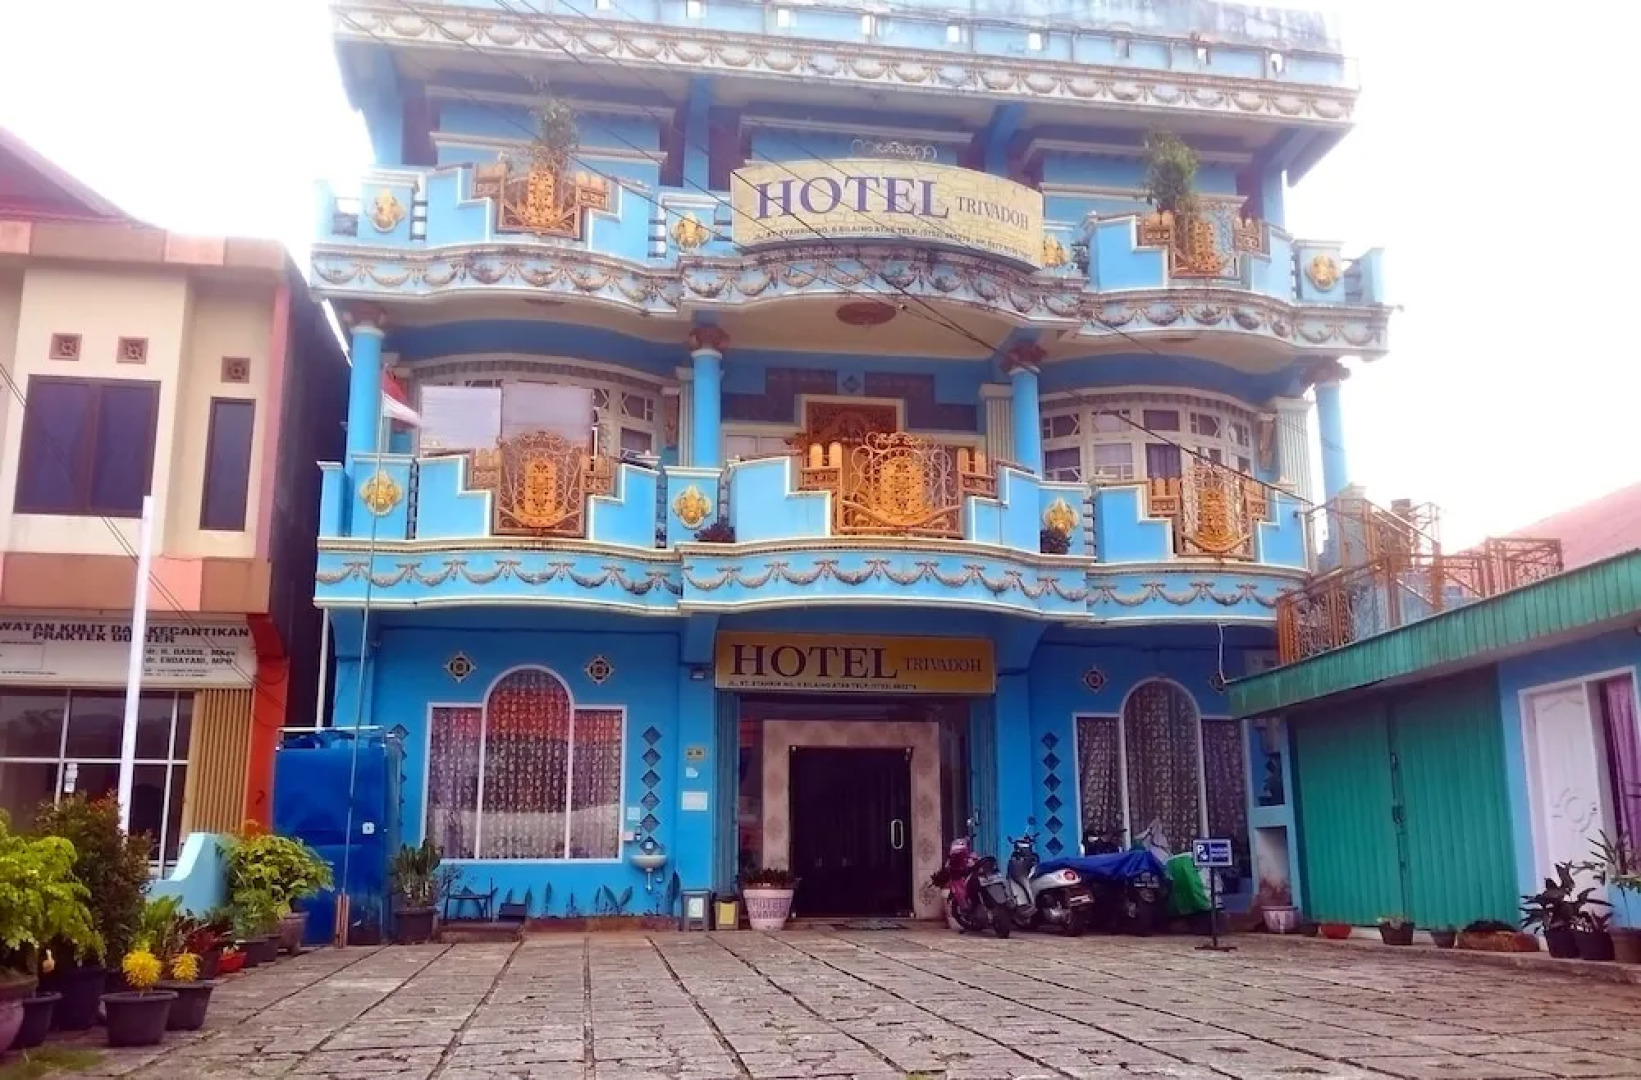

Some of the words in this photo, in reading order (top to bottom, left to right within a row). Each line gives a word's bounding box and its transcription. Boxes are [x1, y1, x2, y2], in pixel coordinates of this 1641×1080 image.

[756, 176, 949, 220] HOTEL
[956, 195, 1030, 231] TRIVADOH
[33, 631, 107, 641] PRAKTEK
[60, 623, 106, 634] KULIT
[111, 624, 132, 634] DA
[148, 626, 249, 637] KECANTIKAN
[730, 644, 899, 679] HOTEL
[906, 656, 982, 673] TRIVADOH
